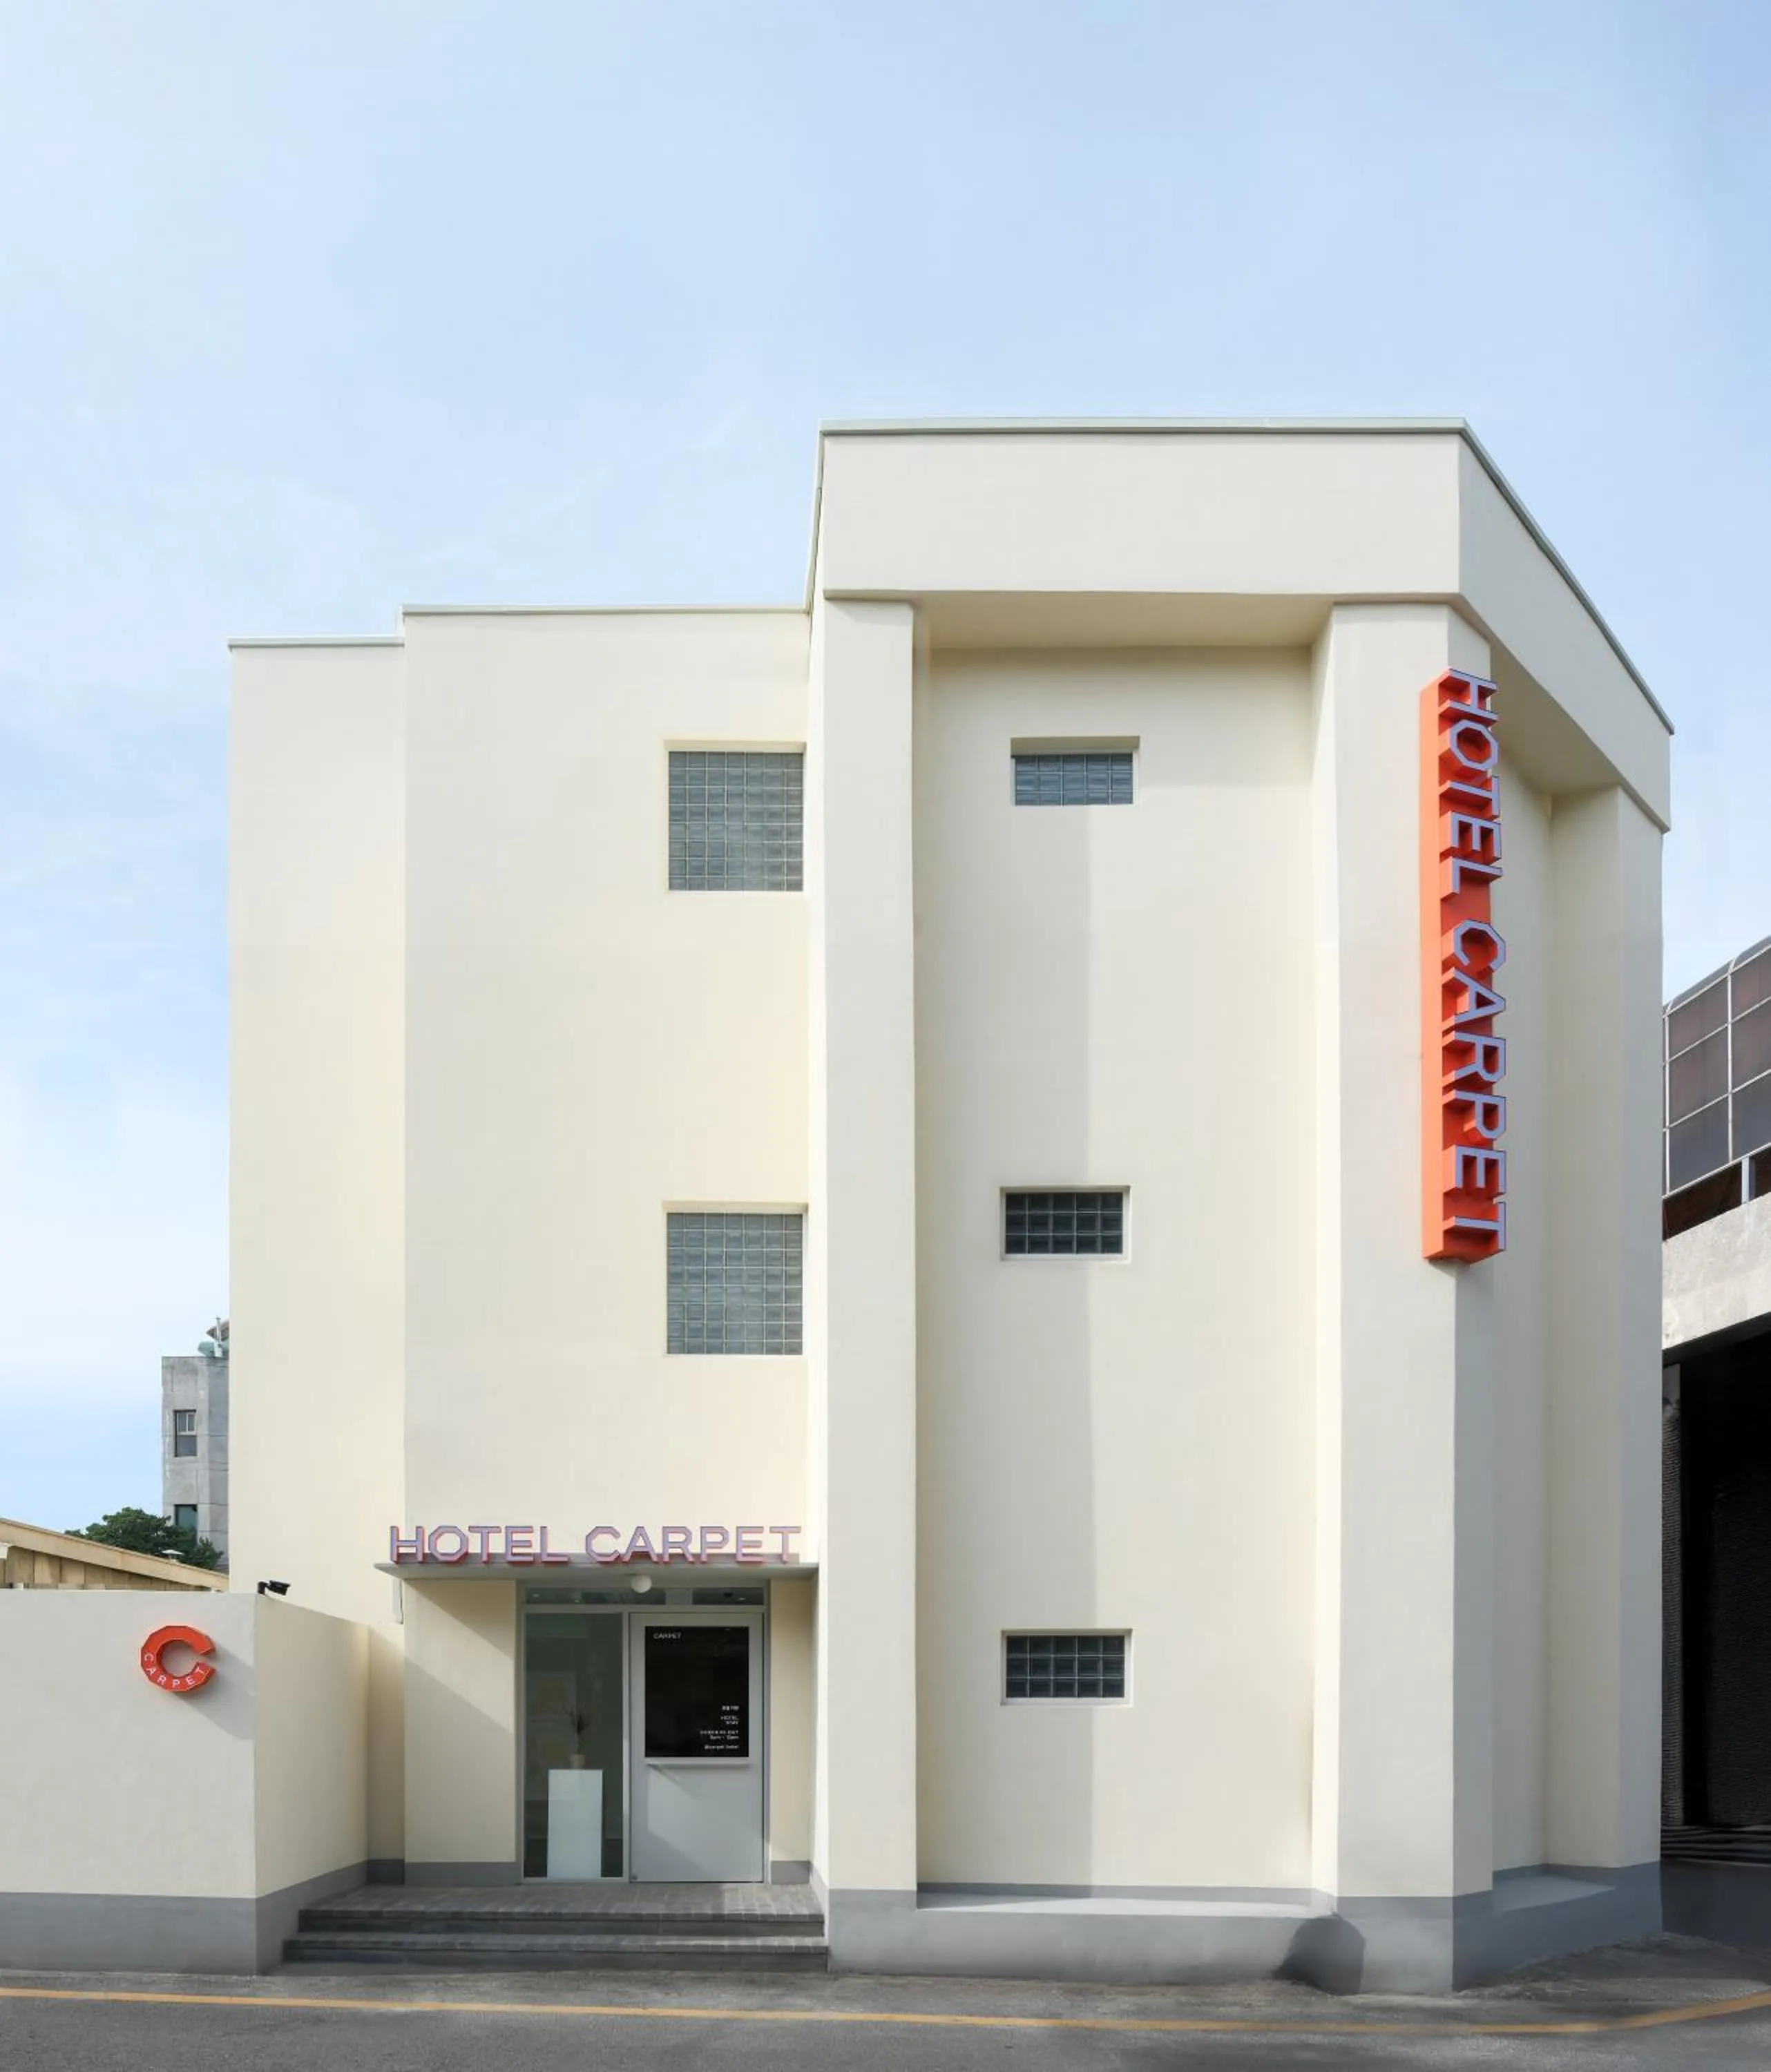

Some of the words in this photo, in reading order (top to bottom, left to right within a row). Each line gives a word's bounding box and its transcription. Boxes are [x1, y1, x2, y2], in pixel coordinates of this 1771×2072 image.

[1448, 668, 1503, 895] HOTEL
[1453, 919, 1506, 1251] CARPET
[390, 1525, 570, 1565] HOTEL
[584, 1525, 802, 1565] CARPET
[144, 1652, 208, 1688] CARPET
